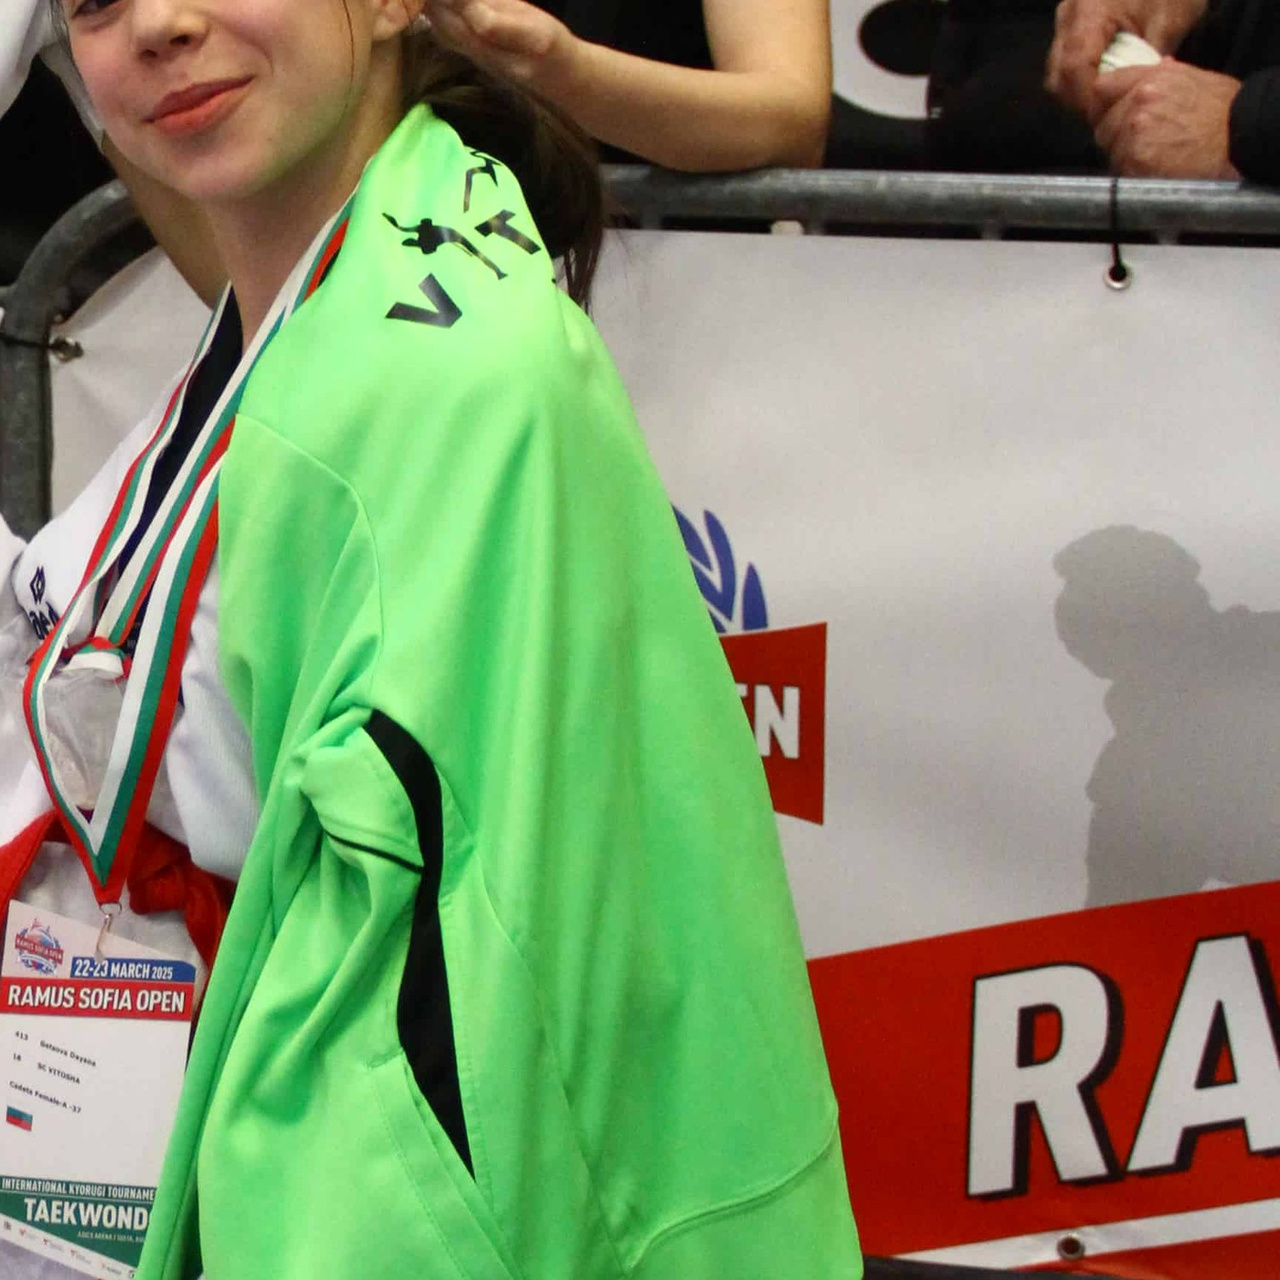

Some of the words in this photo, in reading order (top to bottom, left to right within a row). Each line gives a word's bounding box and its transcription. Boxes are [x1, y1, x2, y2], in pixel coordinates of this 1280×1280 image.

[73, 958, 109, 978] 22-23
[110, 962, 150, 980] MARCH
[151, 966, 173, 980] 2025
[7, 983, 75, 1009] RAMUS
[78, 986, 133, 1012] SOFIA
[136, 989, 186, 1013] OPEN
[2, 1177, 68, 1195] INTERNATIONAL
[69, 1183, 106, 1198] KYORUGI
[107, 1186, 155, 1201] TOURNAME
[24, 1197, 150, 1231] TAEKWOND
